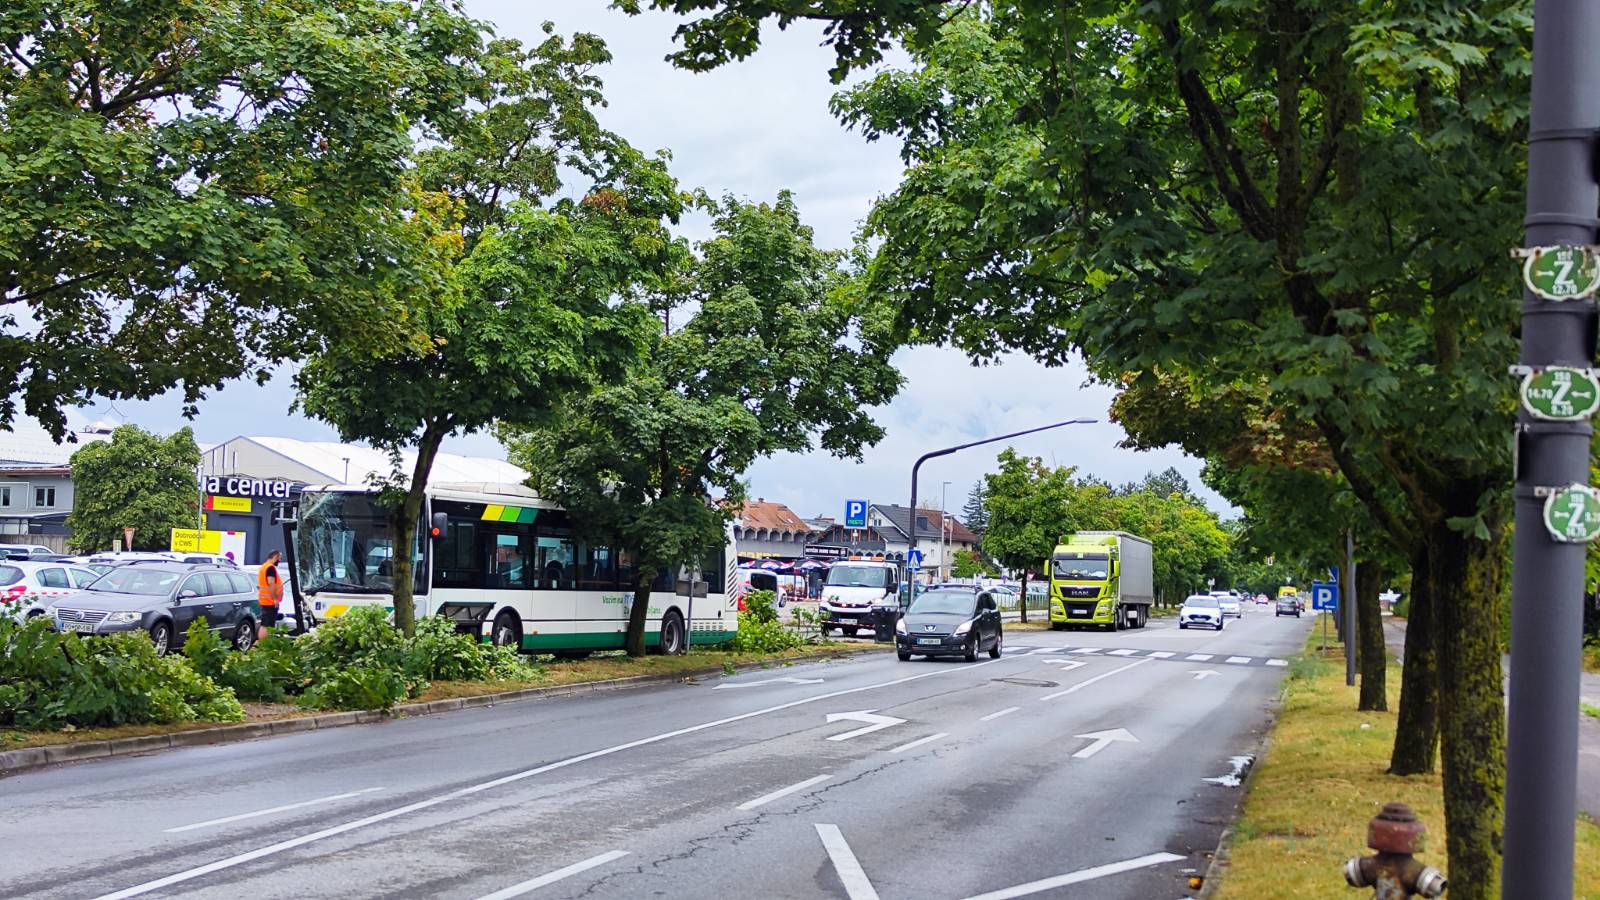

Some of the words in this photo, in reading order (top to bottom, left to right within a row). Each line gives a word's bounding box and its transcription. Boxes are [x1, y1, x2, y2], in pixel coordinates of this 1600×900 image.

[1553, 260, 1574, 285] Z
[1551, 380, 1572, 405] Z
[226, 477, 294, 499] center
[850, 502, 862, 518] P
[1567, 502, 1585, 527] Z
[1318, 588, 1332, 607] P
